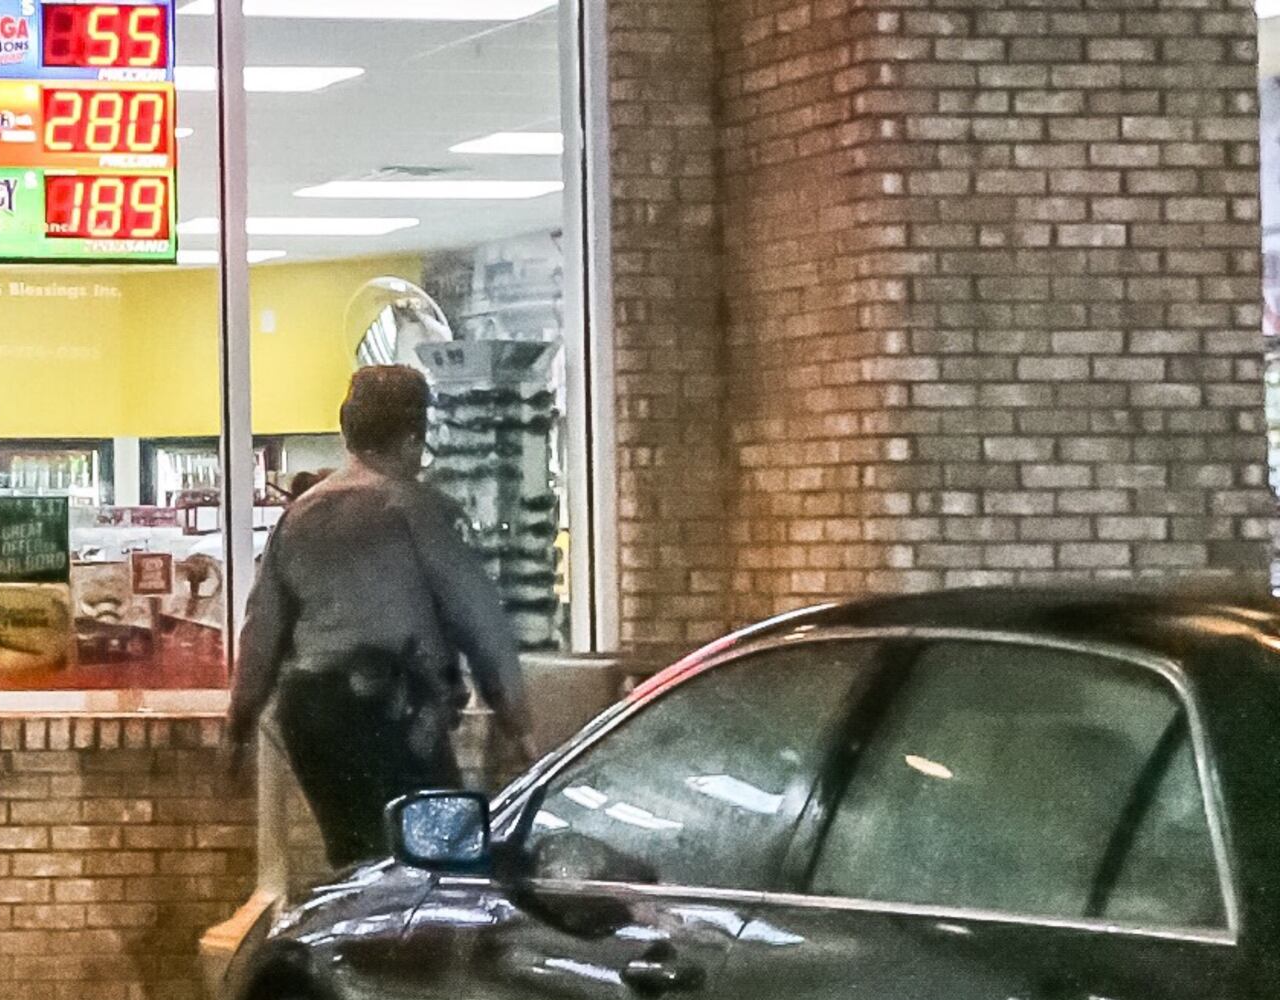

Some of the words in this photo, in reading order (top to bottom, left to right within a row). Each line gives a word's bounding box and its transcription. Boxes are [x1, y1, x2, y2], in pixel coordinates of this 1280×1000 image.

[89, 6, 160, 66] 55
[44, 92, 163, 151] 280
[70, 179, 164, 237] 189
[9, 282, 88, 299] Blessings
